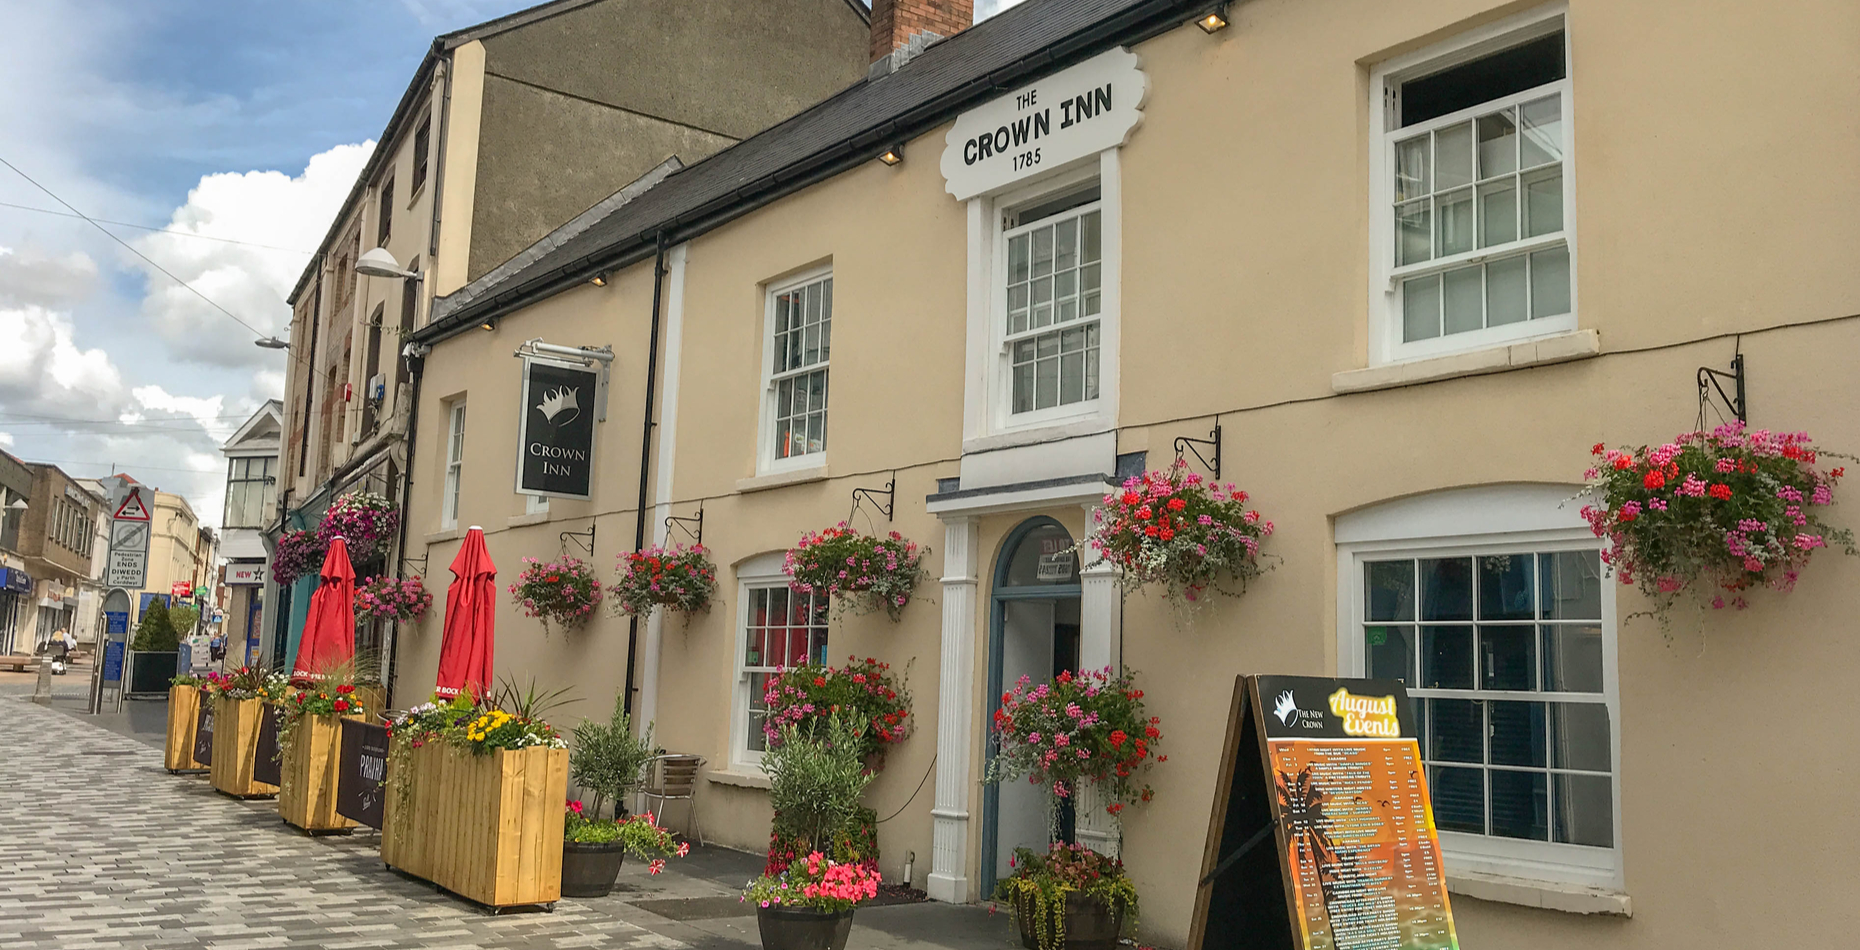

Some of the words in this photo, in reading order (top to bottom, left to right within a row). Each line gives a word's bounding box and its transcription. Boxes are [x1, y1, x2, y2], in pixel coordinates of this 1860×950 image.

[1016, 90, 1037, 110] THE
[964, 108, 1050, 166] CROWN
[1060, 83, 1112, 130] INN
[1012, 148, 1041, 172] 1785
[1330, 690, 1394, 718] August
[1344, 713, 1399, 736] Events
